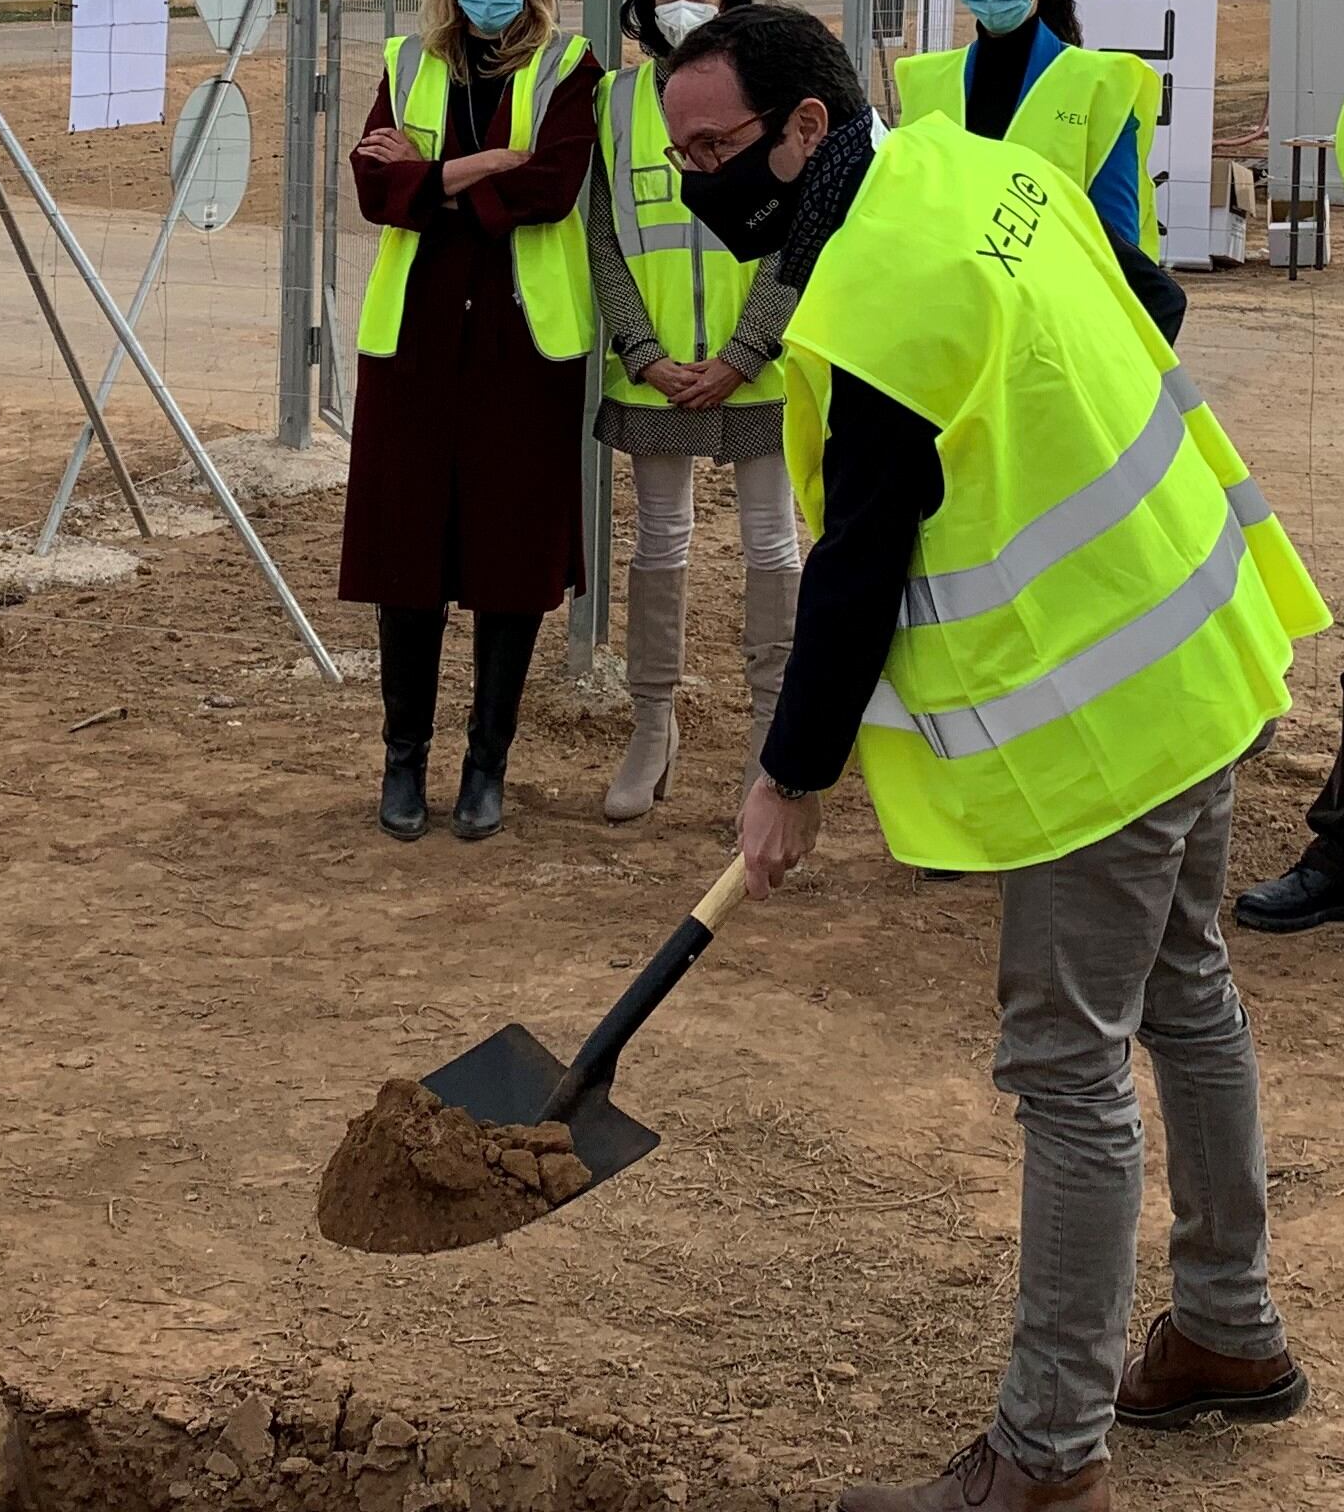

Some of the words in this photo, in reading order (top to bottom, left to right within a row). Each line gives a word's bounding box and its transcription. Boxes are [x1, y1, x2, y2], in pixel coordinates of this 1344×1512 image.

[1055, 109, 1088, 126] X-ELI
[745, 199, 780, 229] X-ELIO
[975, 172, 1048, 278] X-ELIO
